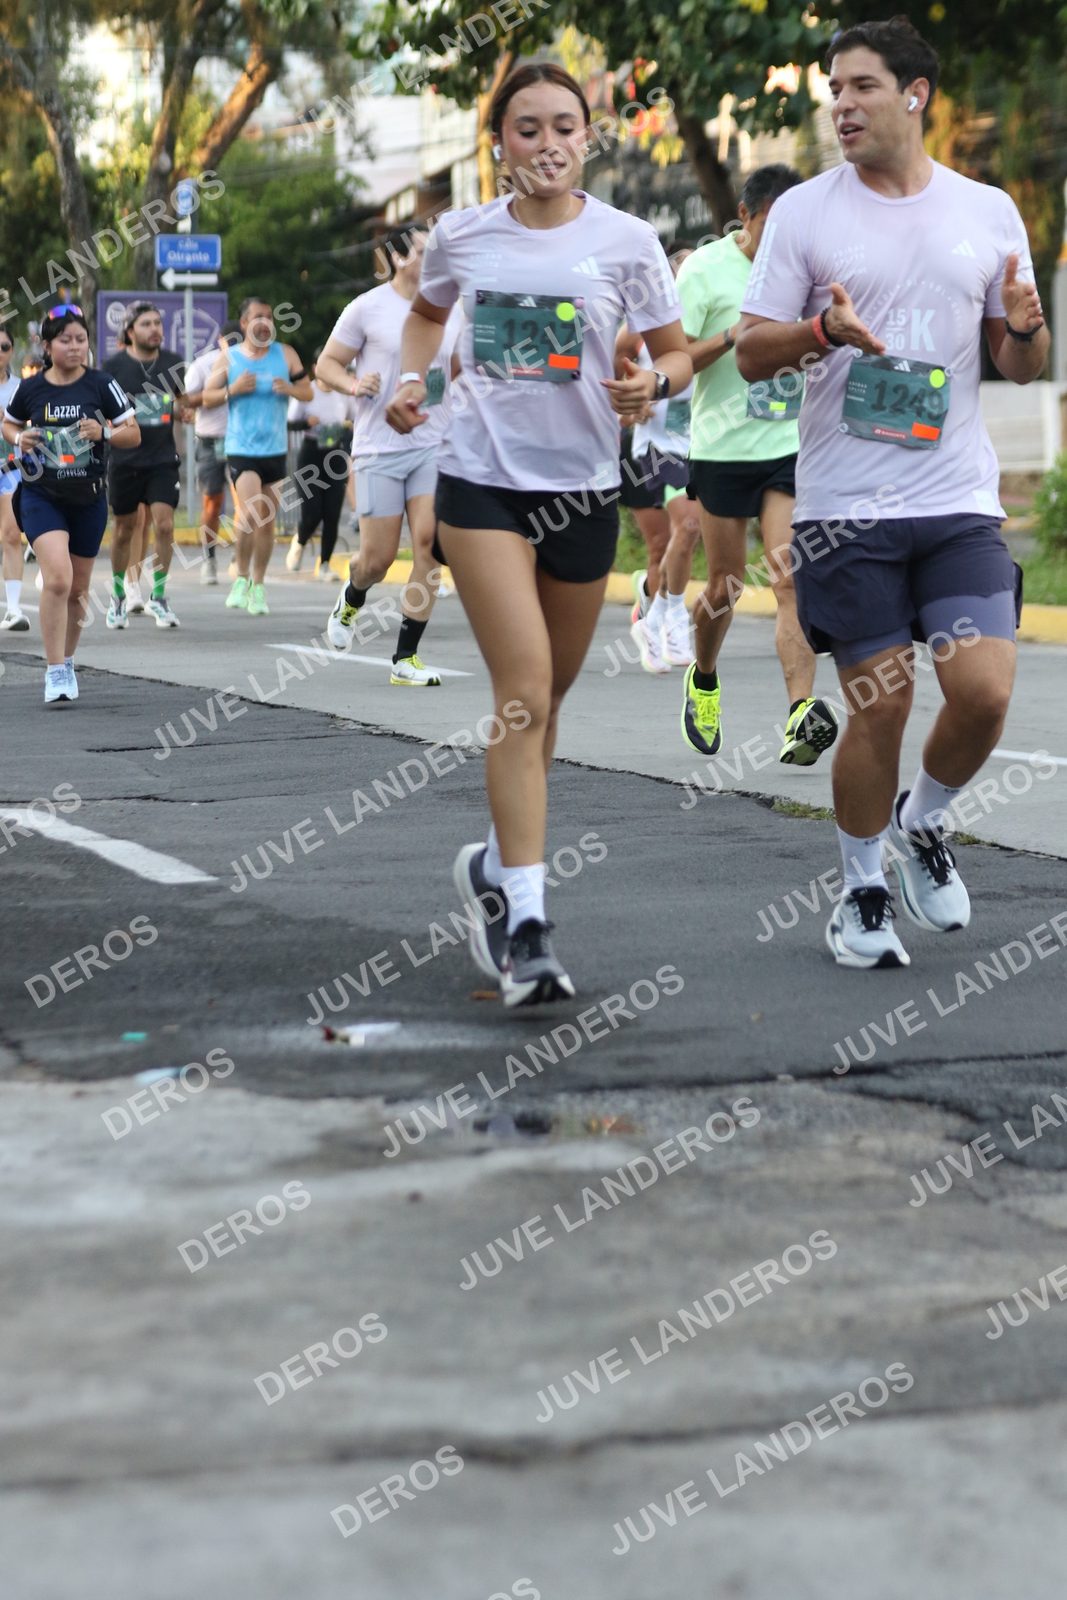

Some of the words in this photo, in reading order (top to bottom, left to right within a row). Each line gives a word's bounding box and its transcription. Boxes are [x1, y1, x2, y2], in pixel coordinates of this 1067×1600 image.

[887, 308, 906, 326] 15
[911, 308, 936, 352] K
[886, 332, 905, 351] 30
[48, 402, 80, 419] Lazzar
